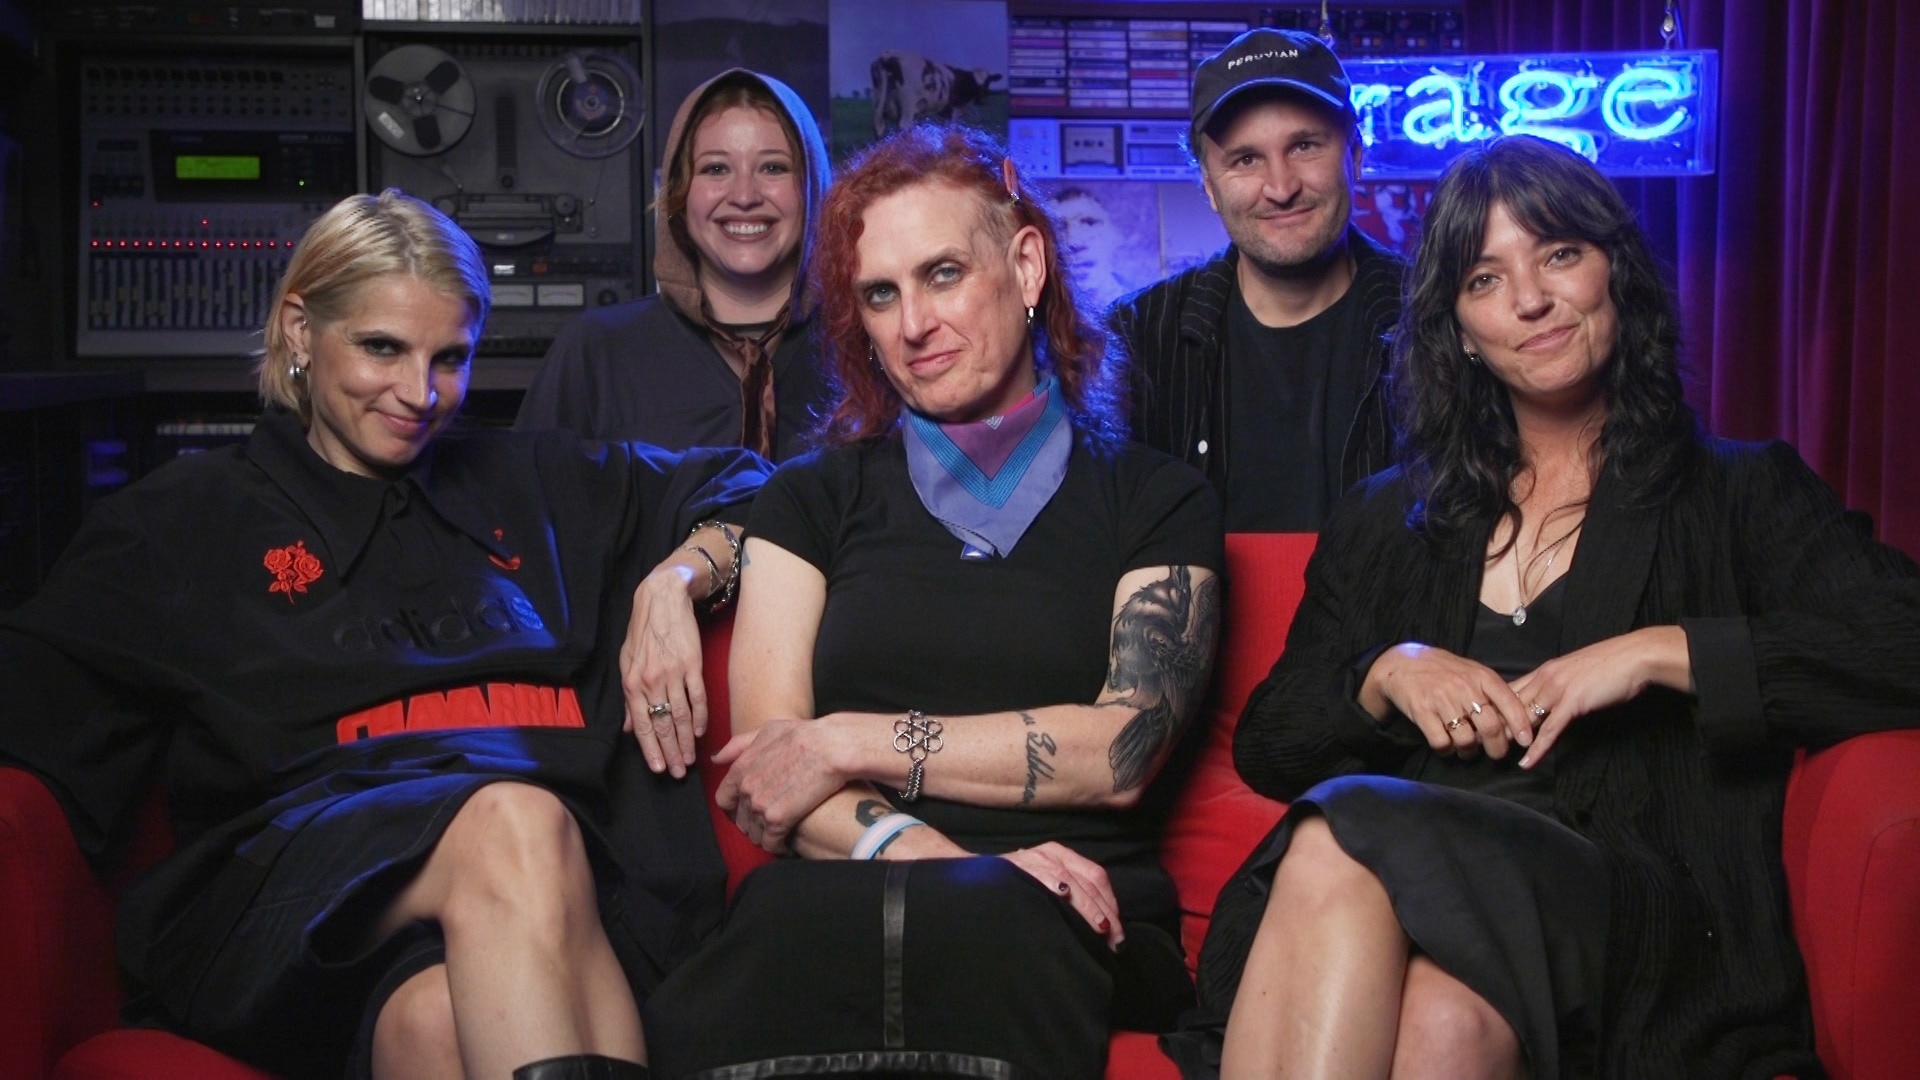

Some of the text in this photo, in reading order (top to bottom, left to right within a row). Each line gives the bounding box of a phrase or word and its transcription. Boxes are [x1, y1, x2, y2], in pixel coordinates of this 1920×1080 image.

[1227, 49, 1298, 70] PERUVIAN
[1350, 66, 1688, 164] rage
[333, 596, 545, 651] adidas
